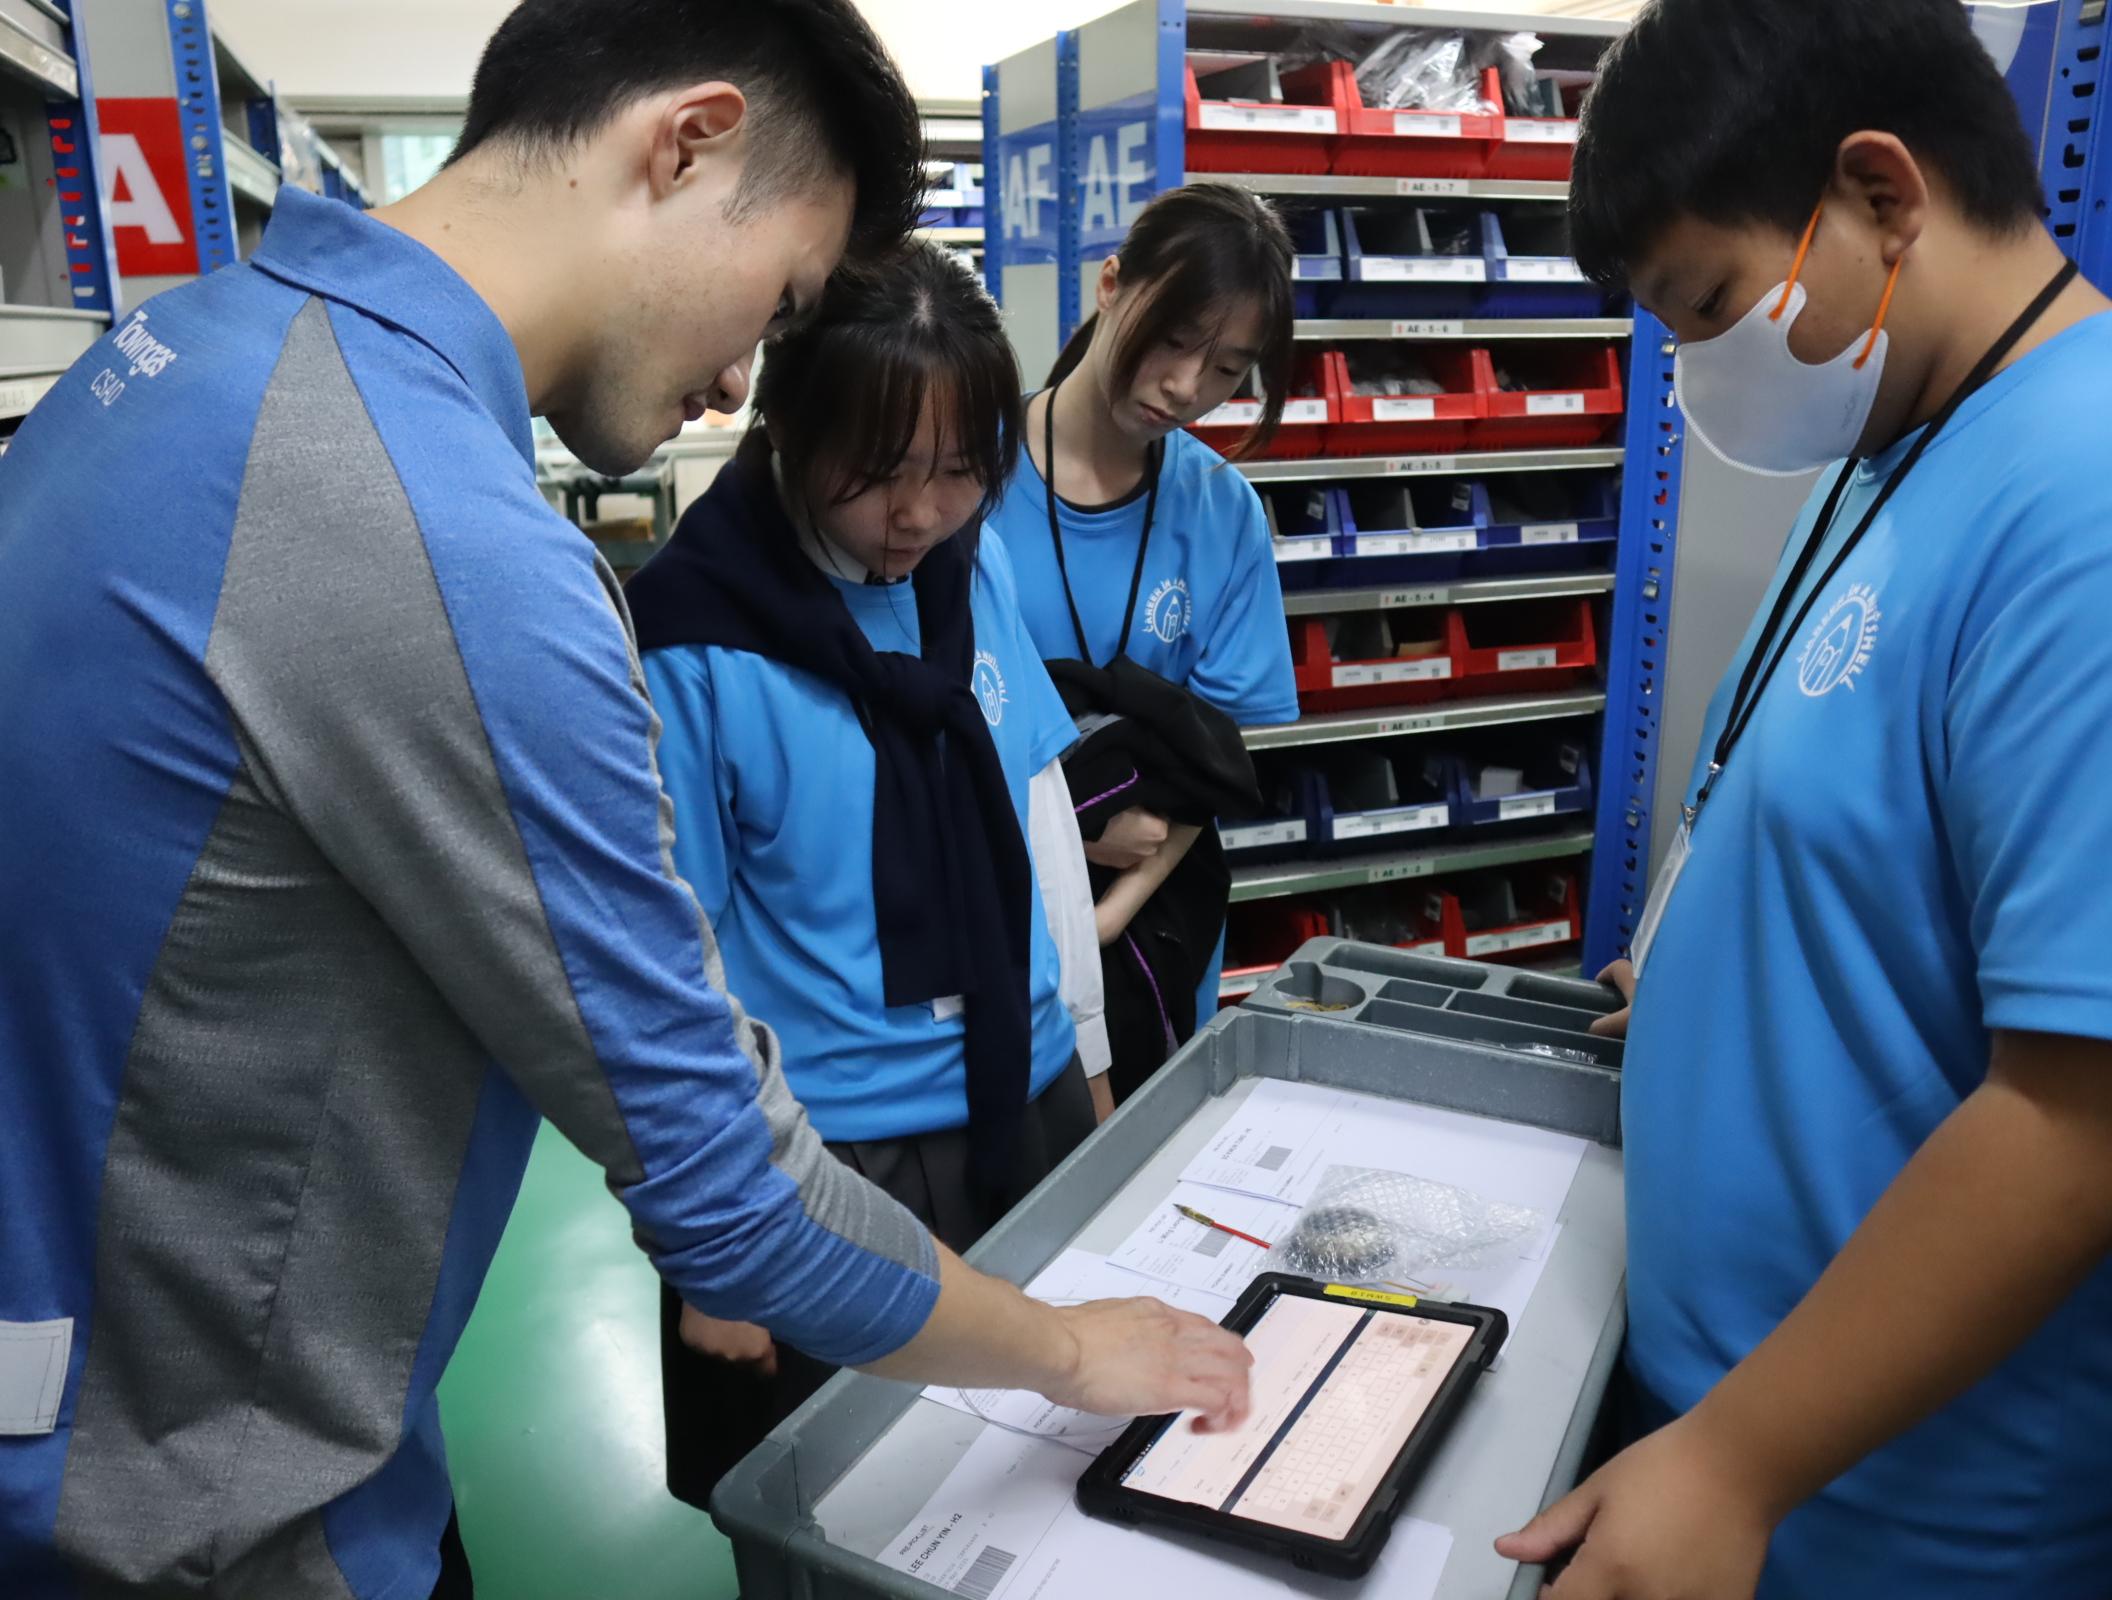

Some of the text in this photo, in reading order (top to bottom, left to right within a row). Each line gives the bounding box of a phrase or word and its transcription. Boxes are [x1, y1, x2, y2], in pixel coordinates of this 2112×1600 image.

[99, 134, 185, 244] A
[1003, 143, 1051, 240] AF
[1081, 121, 1148, 232] AE
[112, 310, 177, 377] Towngas
[907, 1559, 925, 1574] LEE
[920, 1539, 941, 1560] CHUN
[936, 1526, 952, 1540] YIN
[949, 1512, 963, 1524] H2
